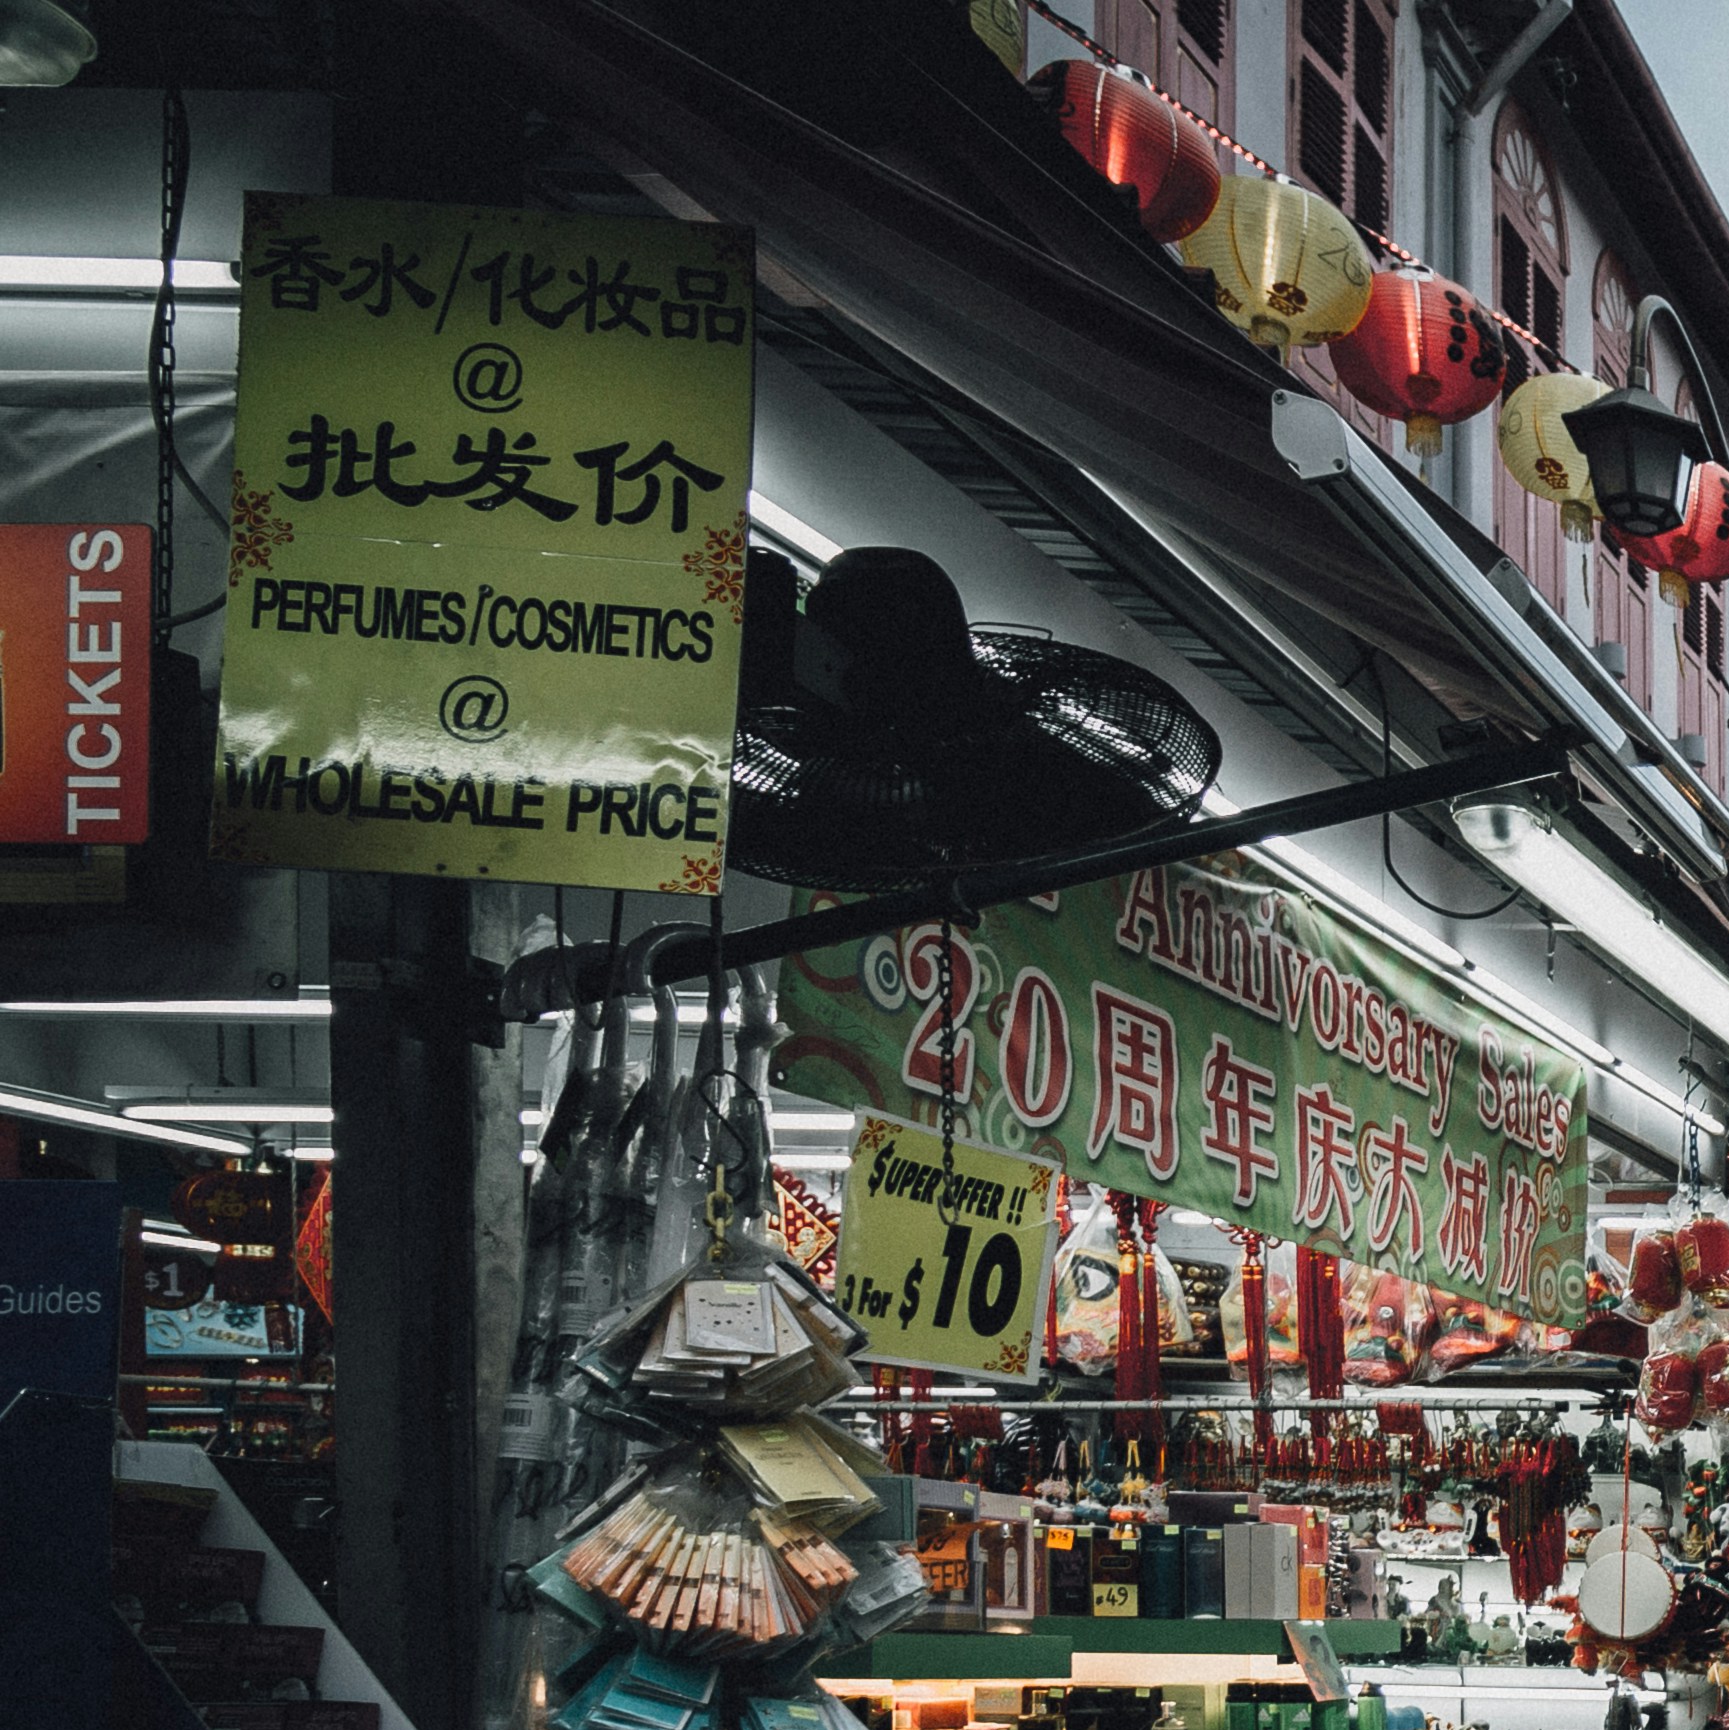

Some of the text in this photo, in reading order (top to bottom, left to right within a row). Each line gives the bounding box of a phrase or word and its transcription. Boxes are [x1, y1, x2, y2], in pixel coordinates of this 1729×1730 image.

[251, 233, 746, 345] 香水/化妆品
[453, 342, 523, 412] @
[278, 415, 725, 533] 批发价
[252, 578, 714, 663] PERFUMES/COSMETICS
[65, 529, 124, 836] TICKETS
[440, 676, 508, 743] @
[223, 754, 719, 842] WHOLESALE PRICE
[1478, 1022, 1572, 1166] Sales
[144, 1262, 184, 1299] $1
[842, 1274, 856, 1313] 3
[858, 1277, 893, 1318] For
[933, 1224, 1022, 1337] 10
